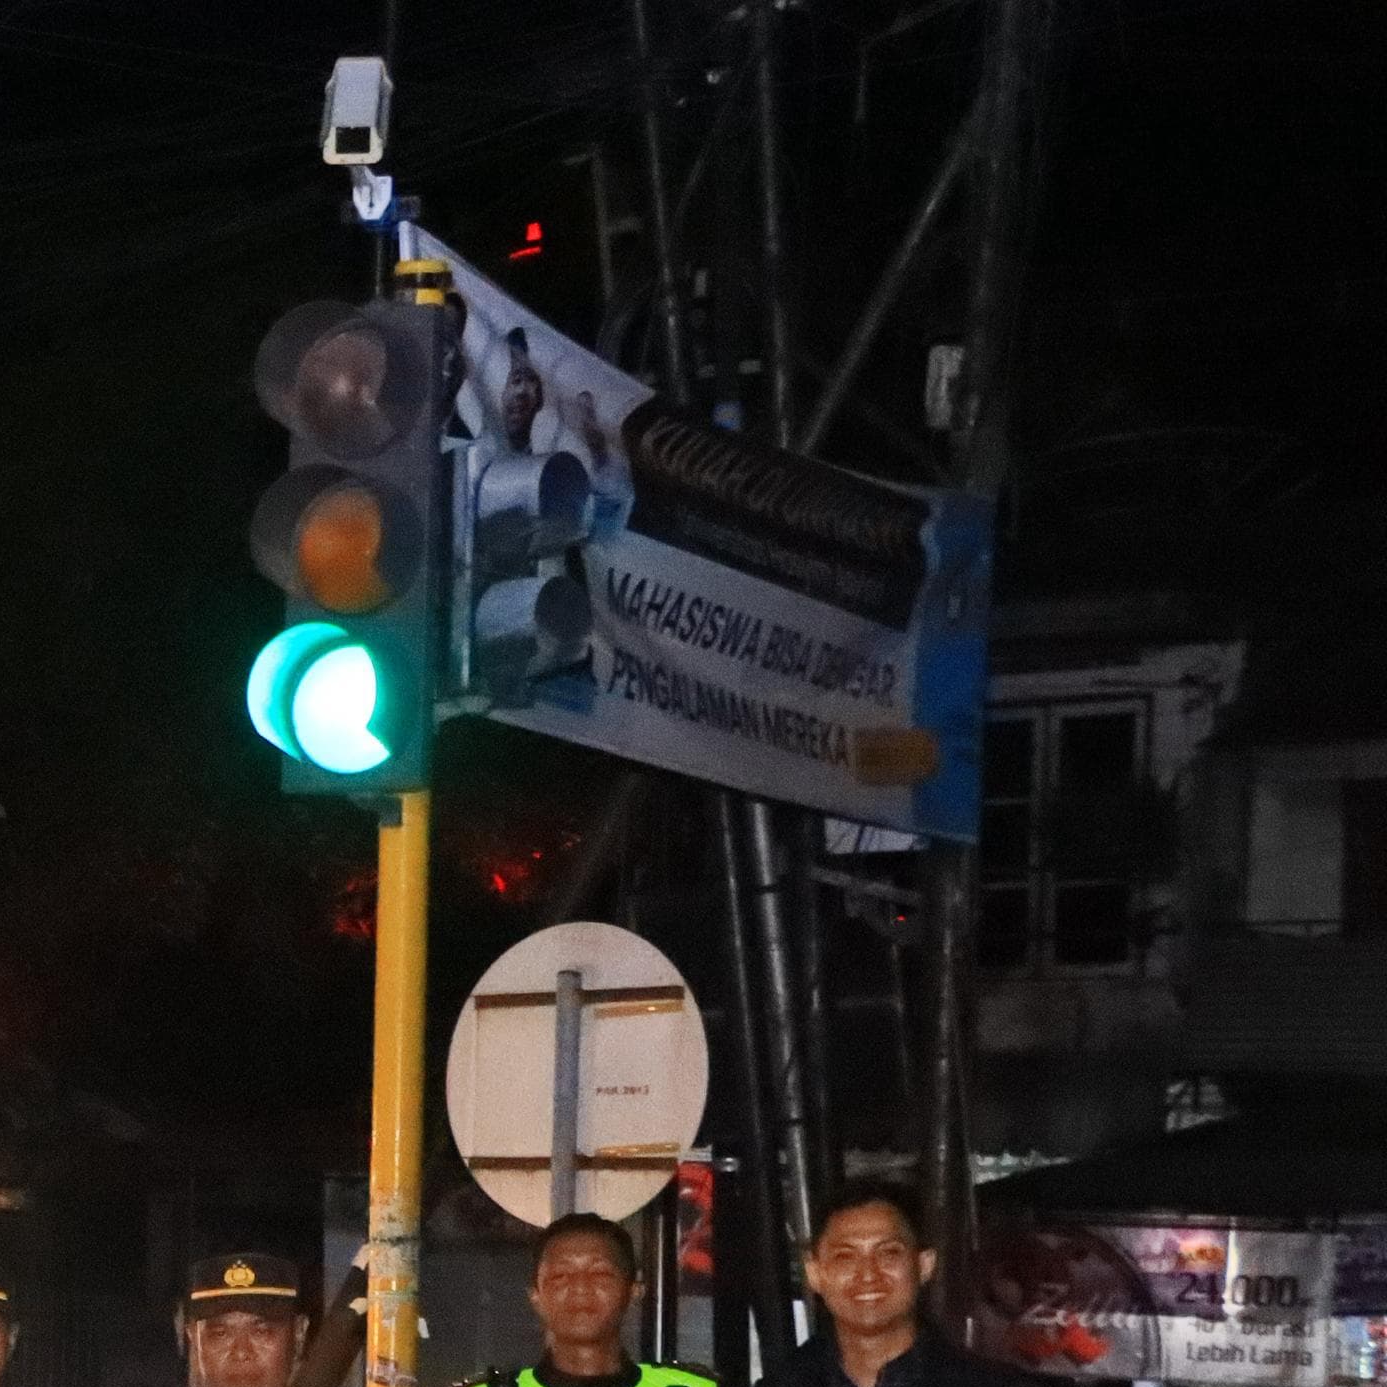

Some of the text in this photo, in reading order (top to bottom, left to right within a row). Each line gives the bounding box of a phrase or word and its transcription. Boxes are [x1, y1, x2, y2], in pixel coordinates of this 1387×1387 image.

[608, 567, 762, 665] MAHASISWA
[761, 624, 812, 680] BISA
[608, 647, 851, 768] PENGALAMAN MEREKA
